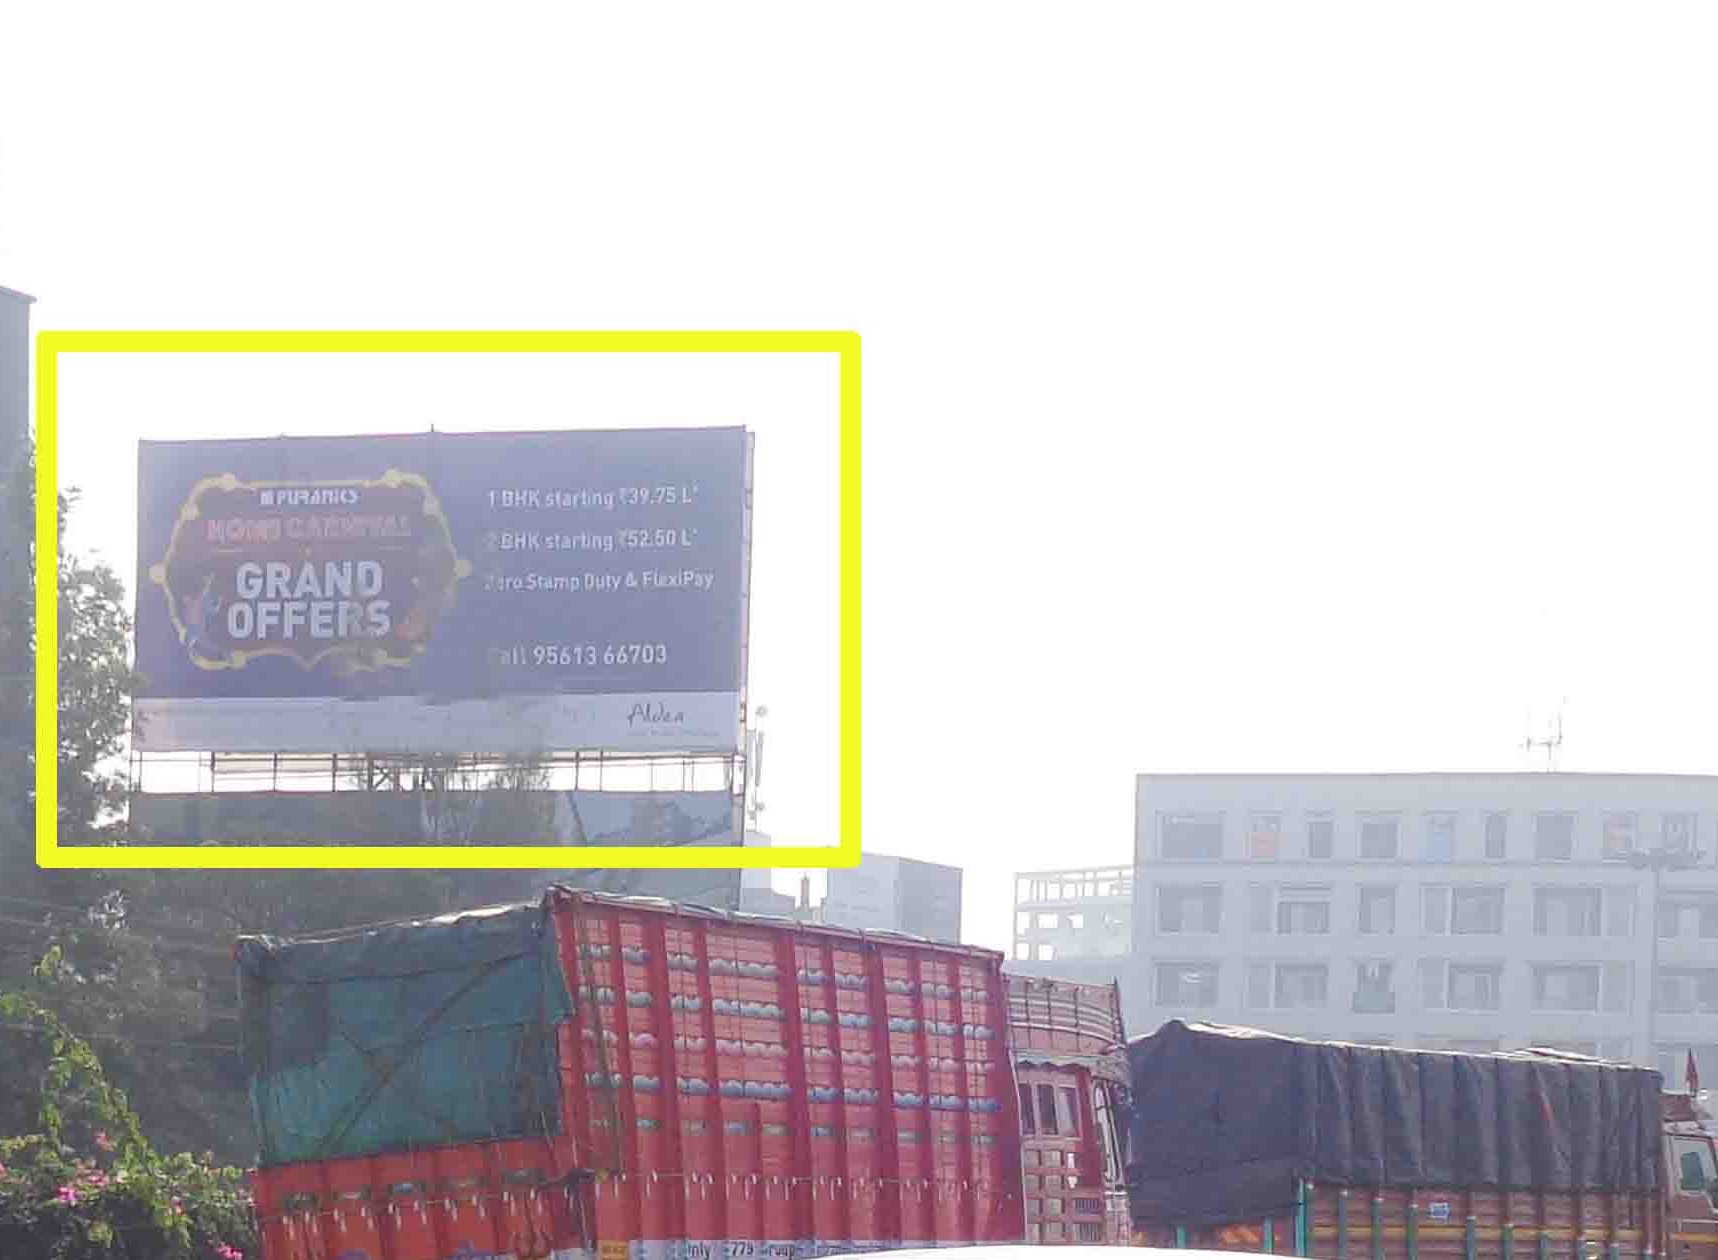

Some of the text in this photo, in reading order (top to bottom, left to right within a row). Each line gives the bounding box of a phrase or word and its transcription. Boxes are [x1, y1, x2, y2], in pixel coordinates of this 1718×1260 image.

[501, 490, 541, 508] BHK
[546, 488, 616, 510] starting
[500, 532, 541, 550] BHK
[545, 531, 614, 552] starting
[236, 560, 384, 600] GRAND
[529, 572, 581, 592] Stamp
[584, 571, 622, 592] Duty
[626, 571, 639, 588] &
[642, 567, 715, 590] FlexiPay
[227, 600, 392, 640] OFFERS
[533, 645, 598, 666] 95613
[603, 643, 669, 665] 66703
